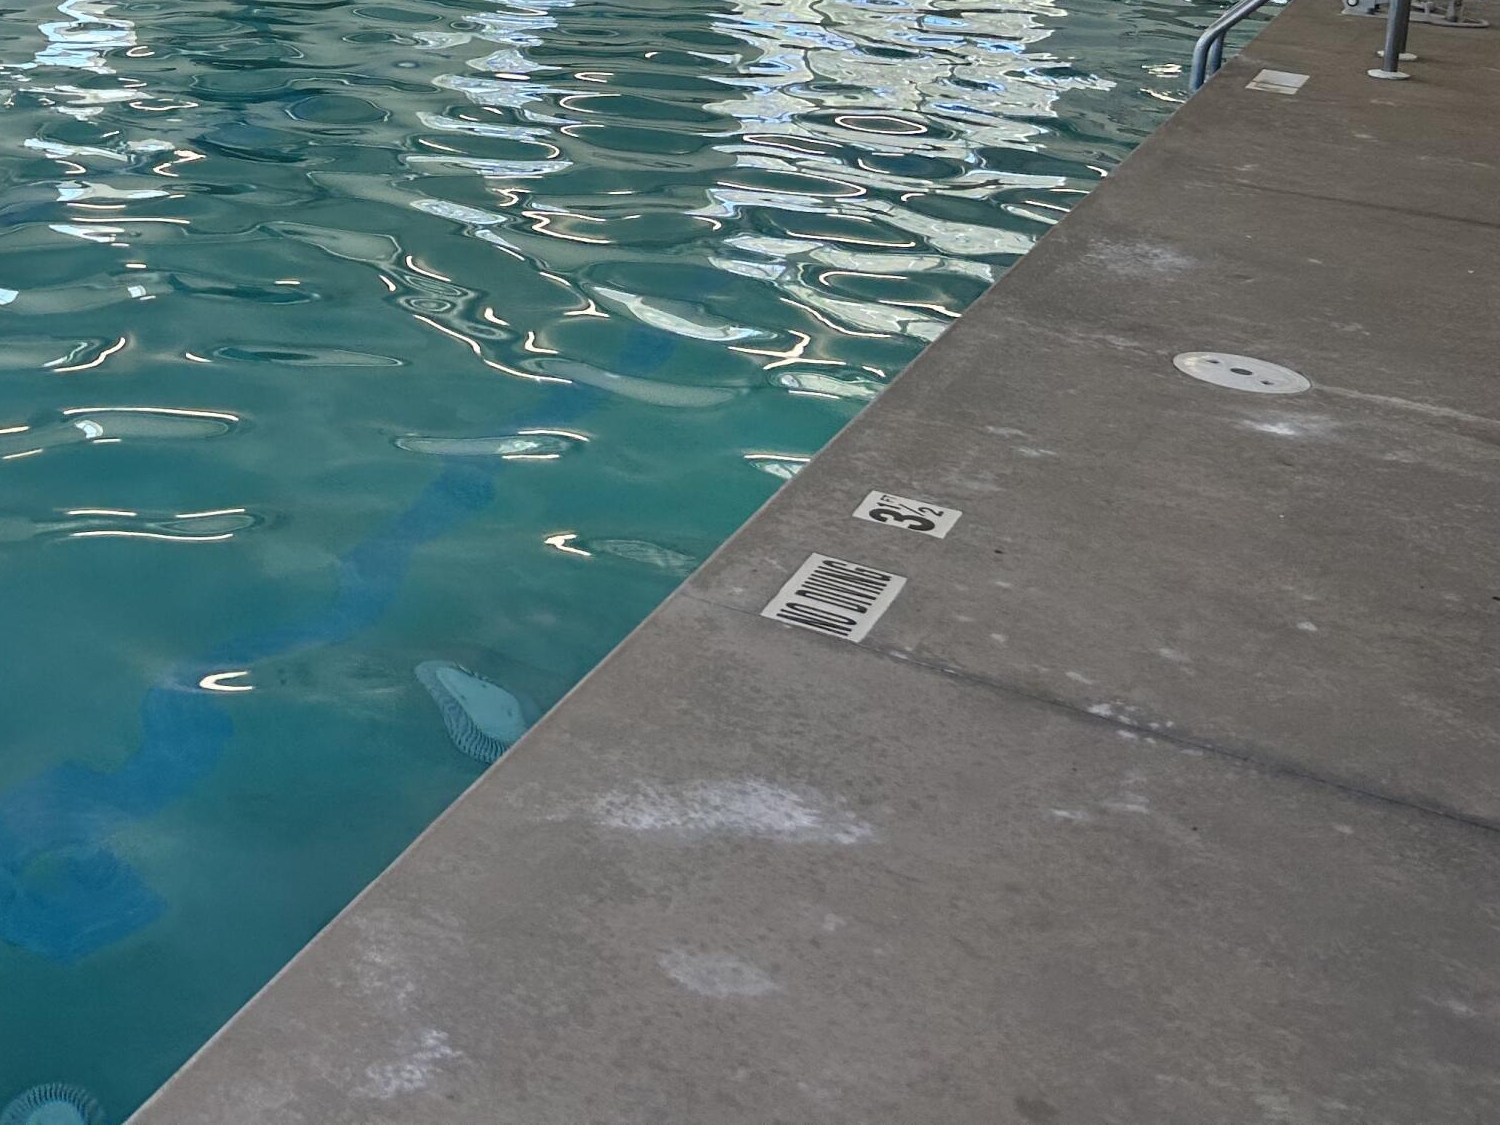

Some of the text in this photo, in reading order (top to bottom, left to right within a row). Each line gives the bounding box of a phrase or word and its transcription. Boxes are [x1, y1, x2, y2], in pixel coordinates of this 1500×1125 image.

[880, 494, 897, 504] FT
[868, 508, 936, 532] 3
[776, 560, 891, 636] NO DIVING
